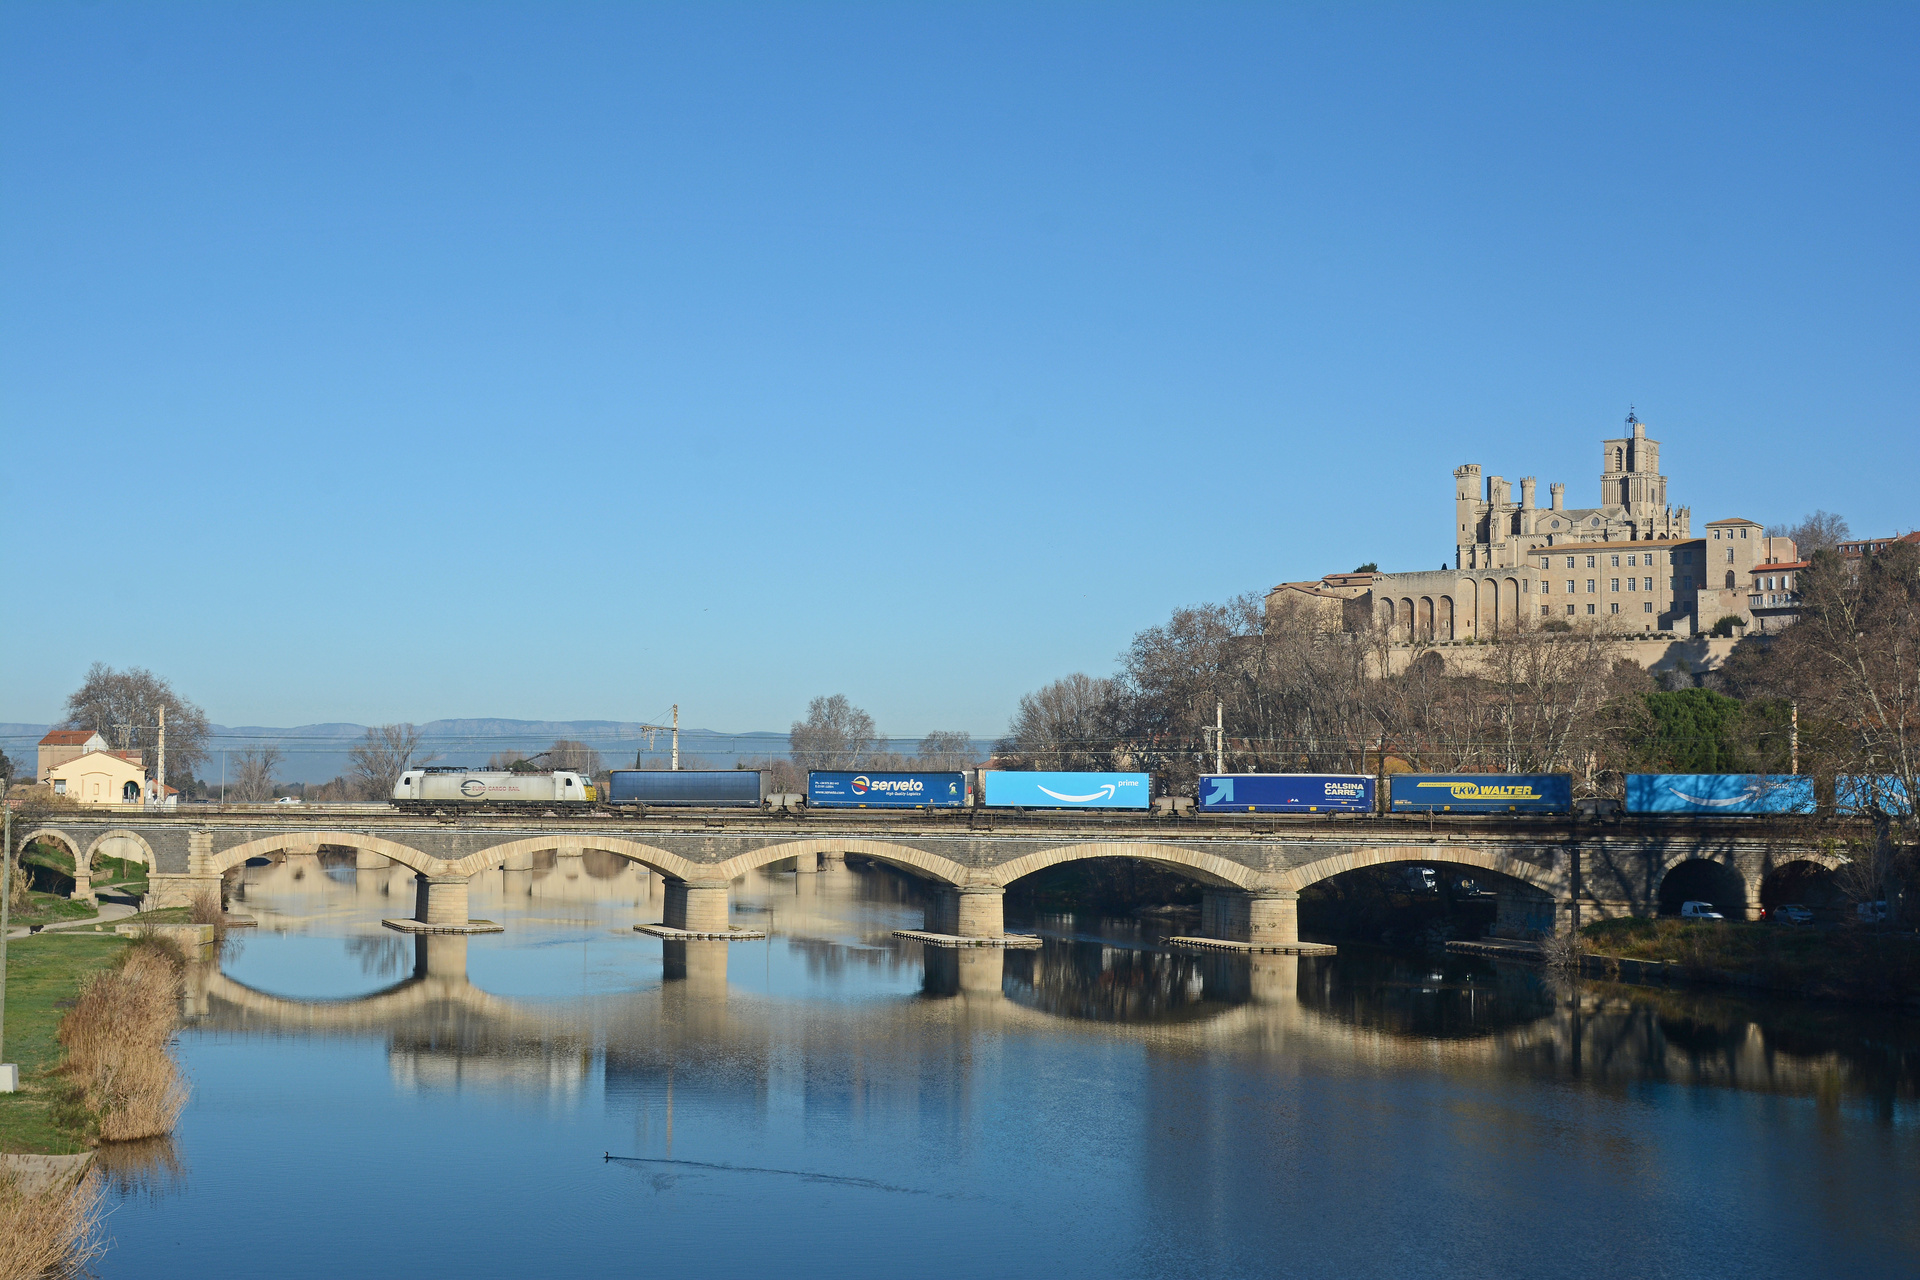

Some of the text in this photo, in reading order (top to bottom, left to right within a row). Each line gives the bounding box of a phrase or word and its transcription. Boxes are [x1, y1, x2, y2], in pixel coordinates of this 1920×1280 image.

[871, 779, 923, 791] serveto
[1118, 779, 1139, 788] prime
[1324, 782, 1364, 790] CALSINA
[1324, 788, 1356, 796] CARRE
[1453, 785, 1533, 795] LKW WALTER
